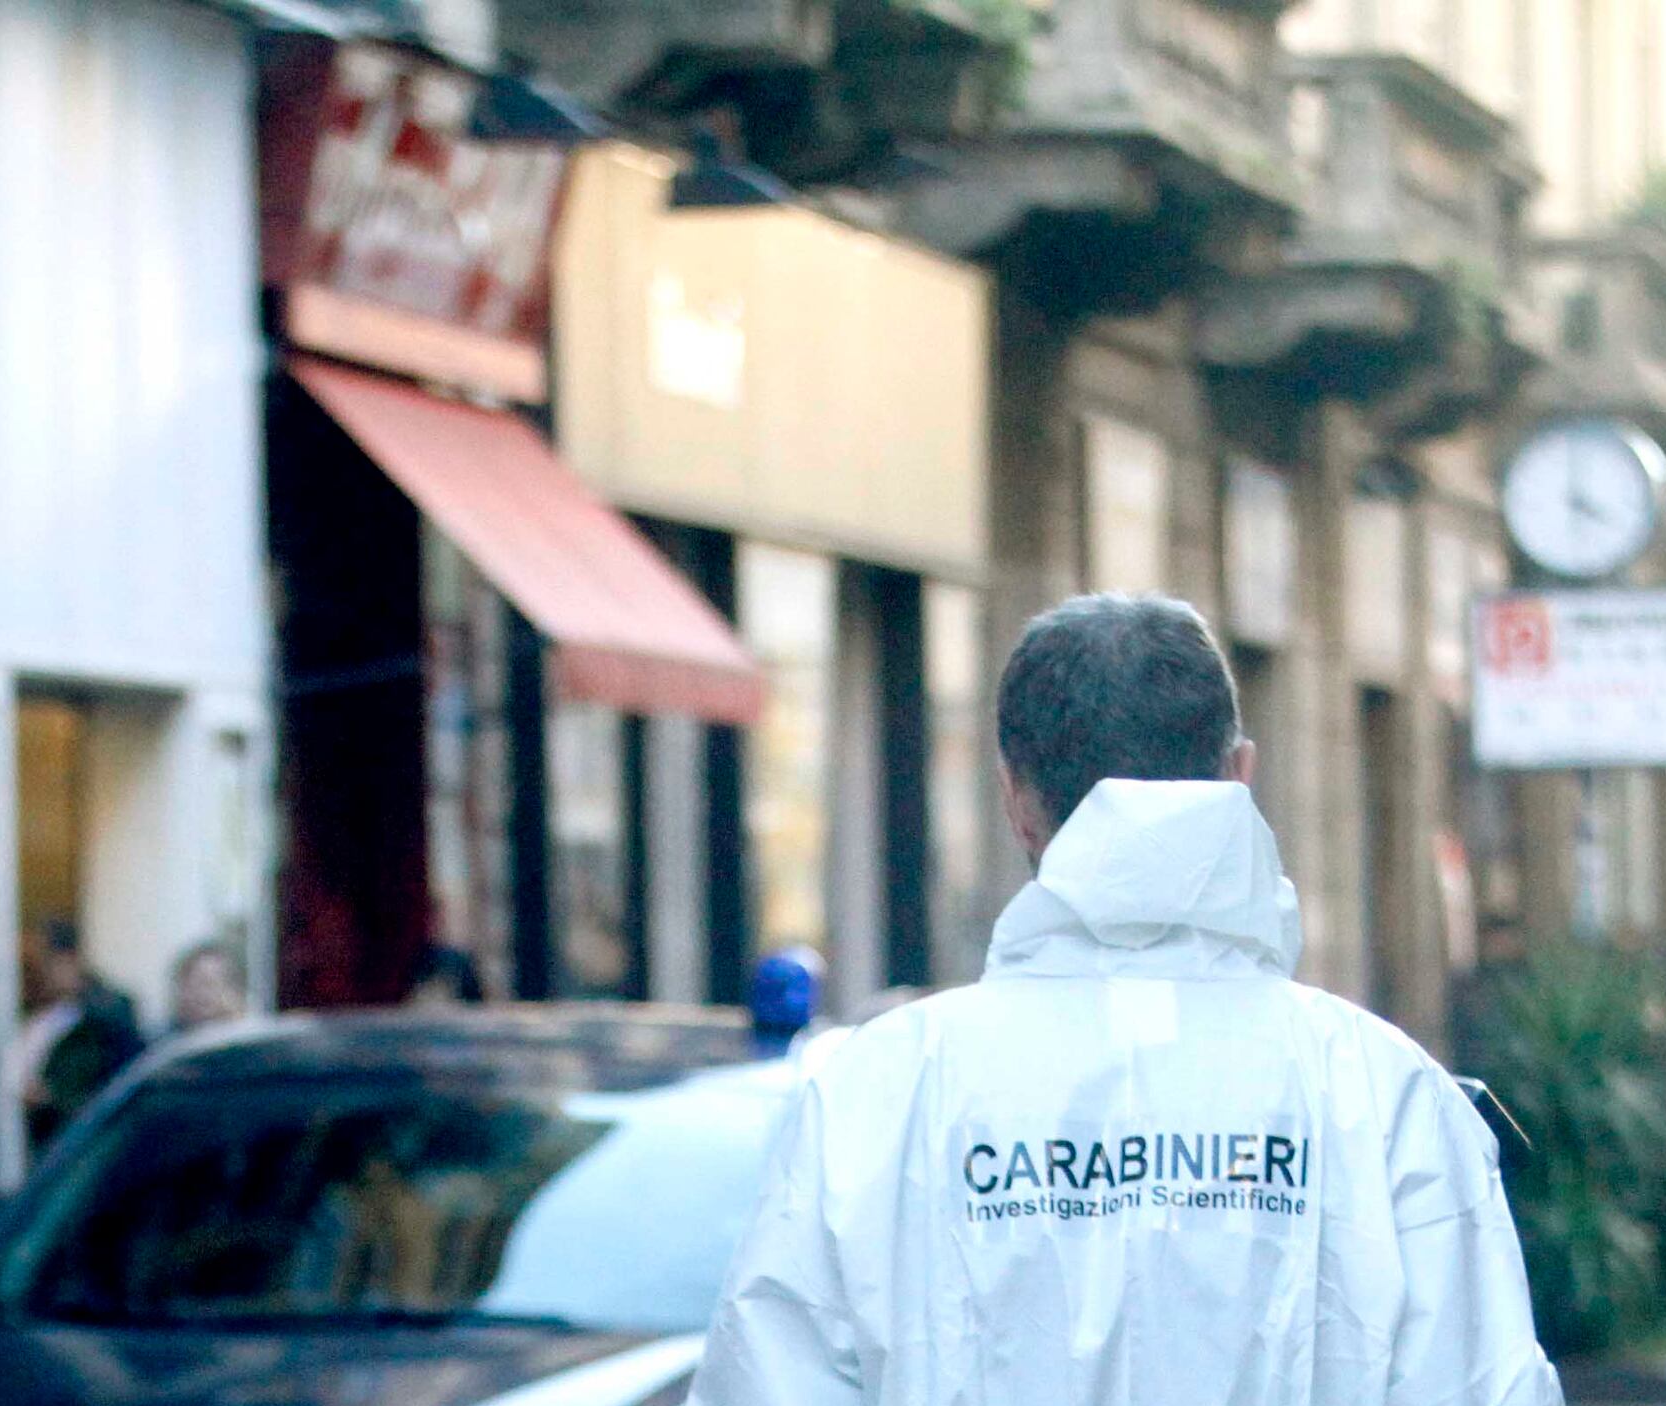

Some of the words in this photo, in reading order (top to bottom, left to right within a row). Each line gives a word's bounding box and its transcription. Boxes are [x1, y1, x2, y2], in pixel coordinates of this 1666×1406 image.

[963, 1133, 1309, 1195] CARABINIERI
[966, 1187, 1142, 1222] Investigazioni
[1151, 1185, 1307, 1217] Scientifiche
